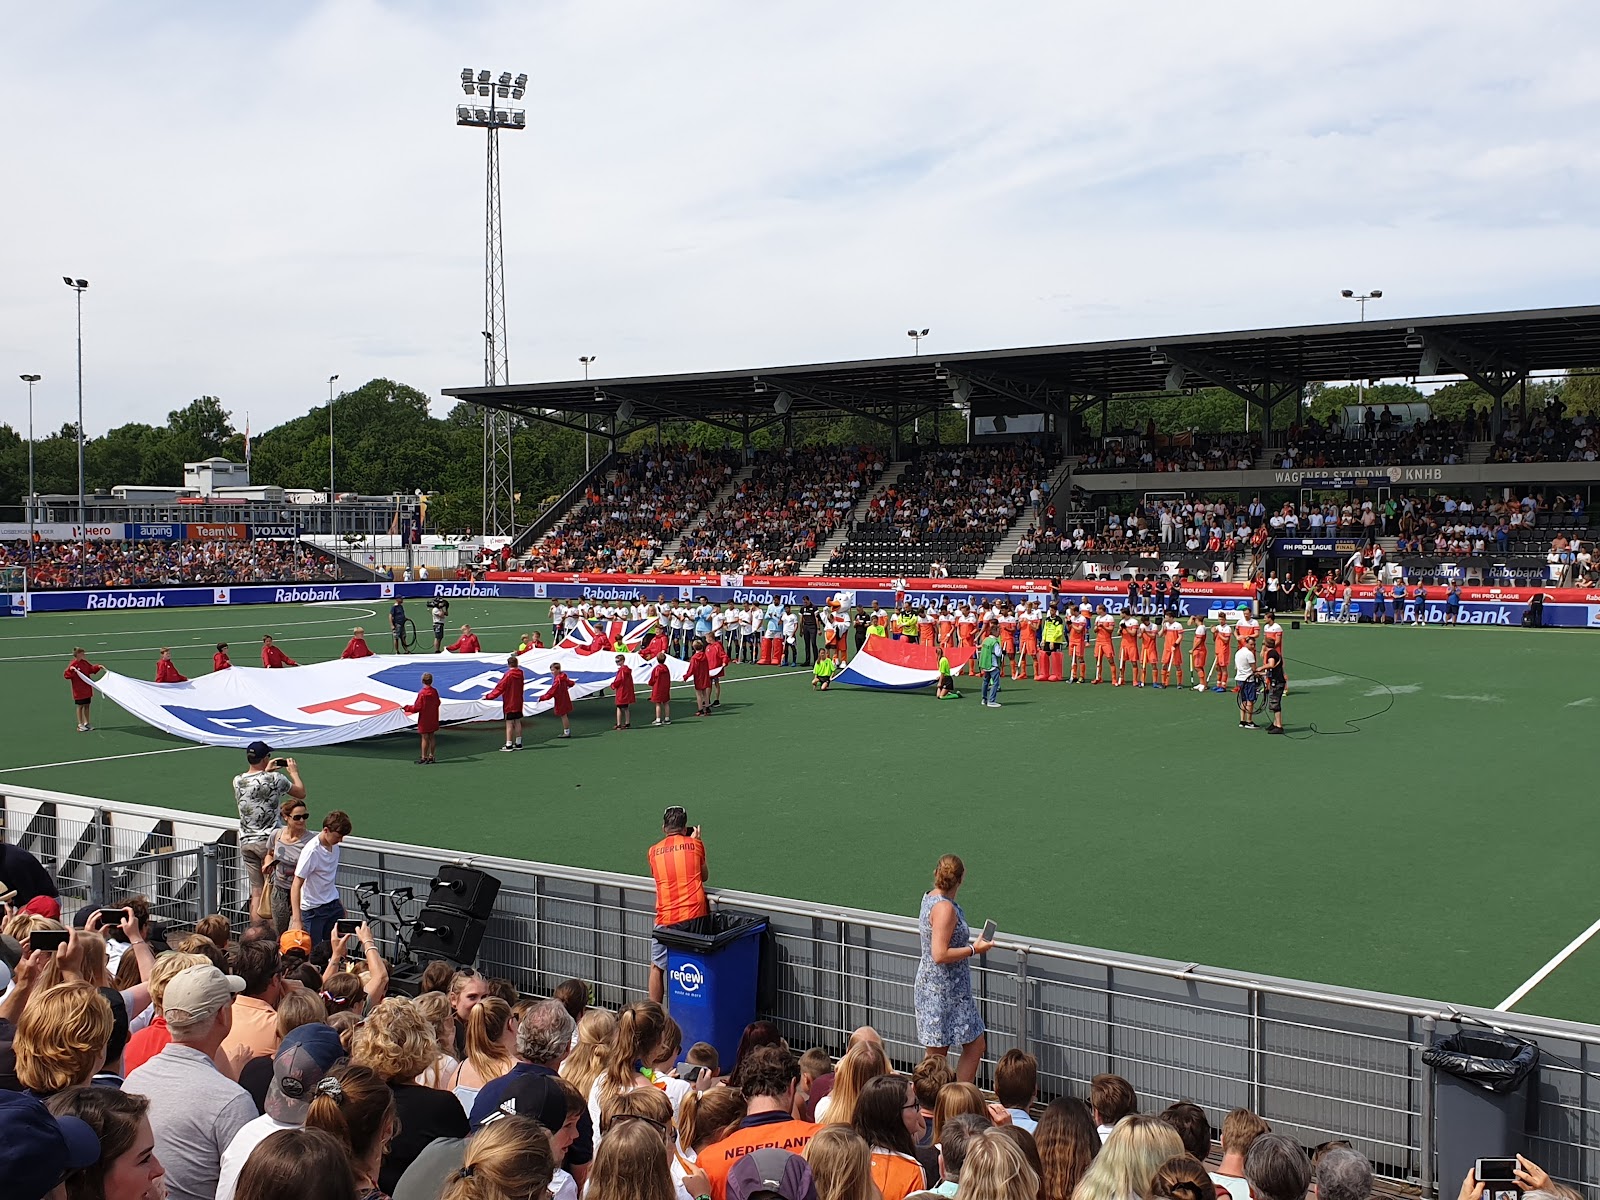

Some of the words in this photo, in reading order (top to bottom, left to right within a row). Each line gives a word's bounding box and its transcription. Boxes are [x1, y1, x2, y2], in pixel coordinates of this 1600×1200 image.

[1405, 468, 1442, 480] KNHB
[140, 526, 172, 537] auping
[196, 525, 238, 536] TeamNL
[251, 526, 295, 536] VOLVO
[1489, 565, 1543, 578] Rabobank
[275, 587, 340, 602] Rabobank
[434, 584, 500, 597] Rabobank
[583, 586, 640, 601] Rabobank
[733, 589, 796, 605] Rabobnk
[86, 592, 165, 610] Rabobank
[670, 970, 704, 984] renewi
